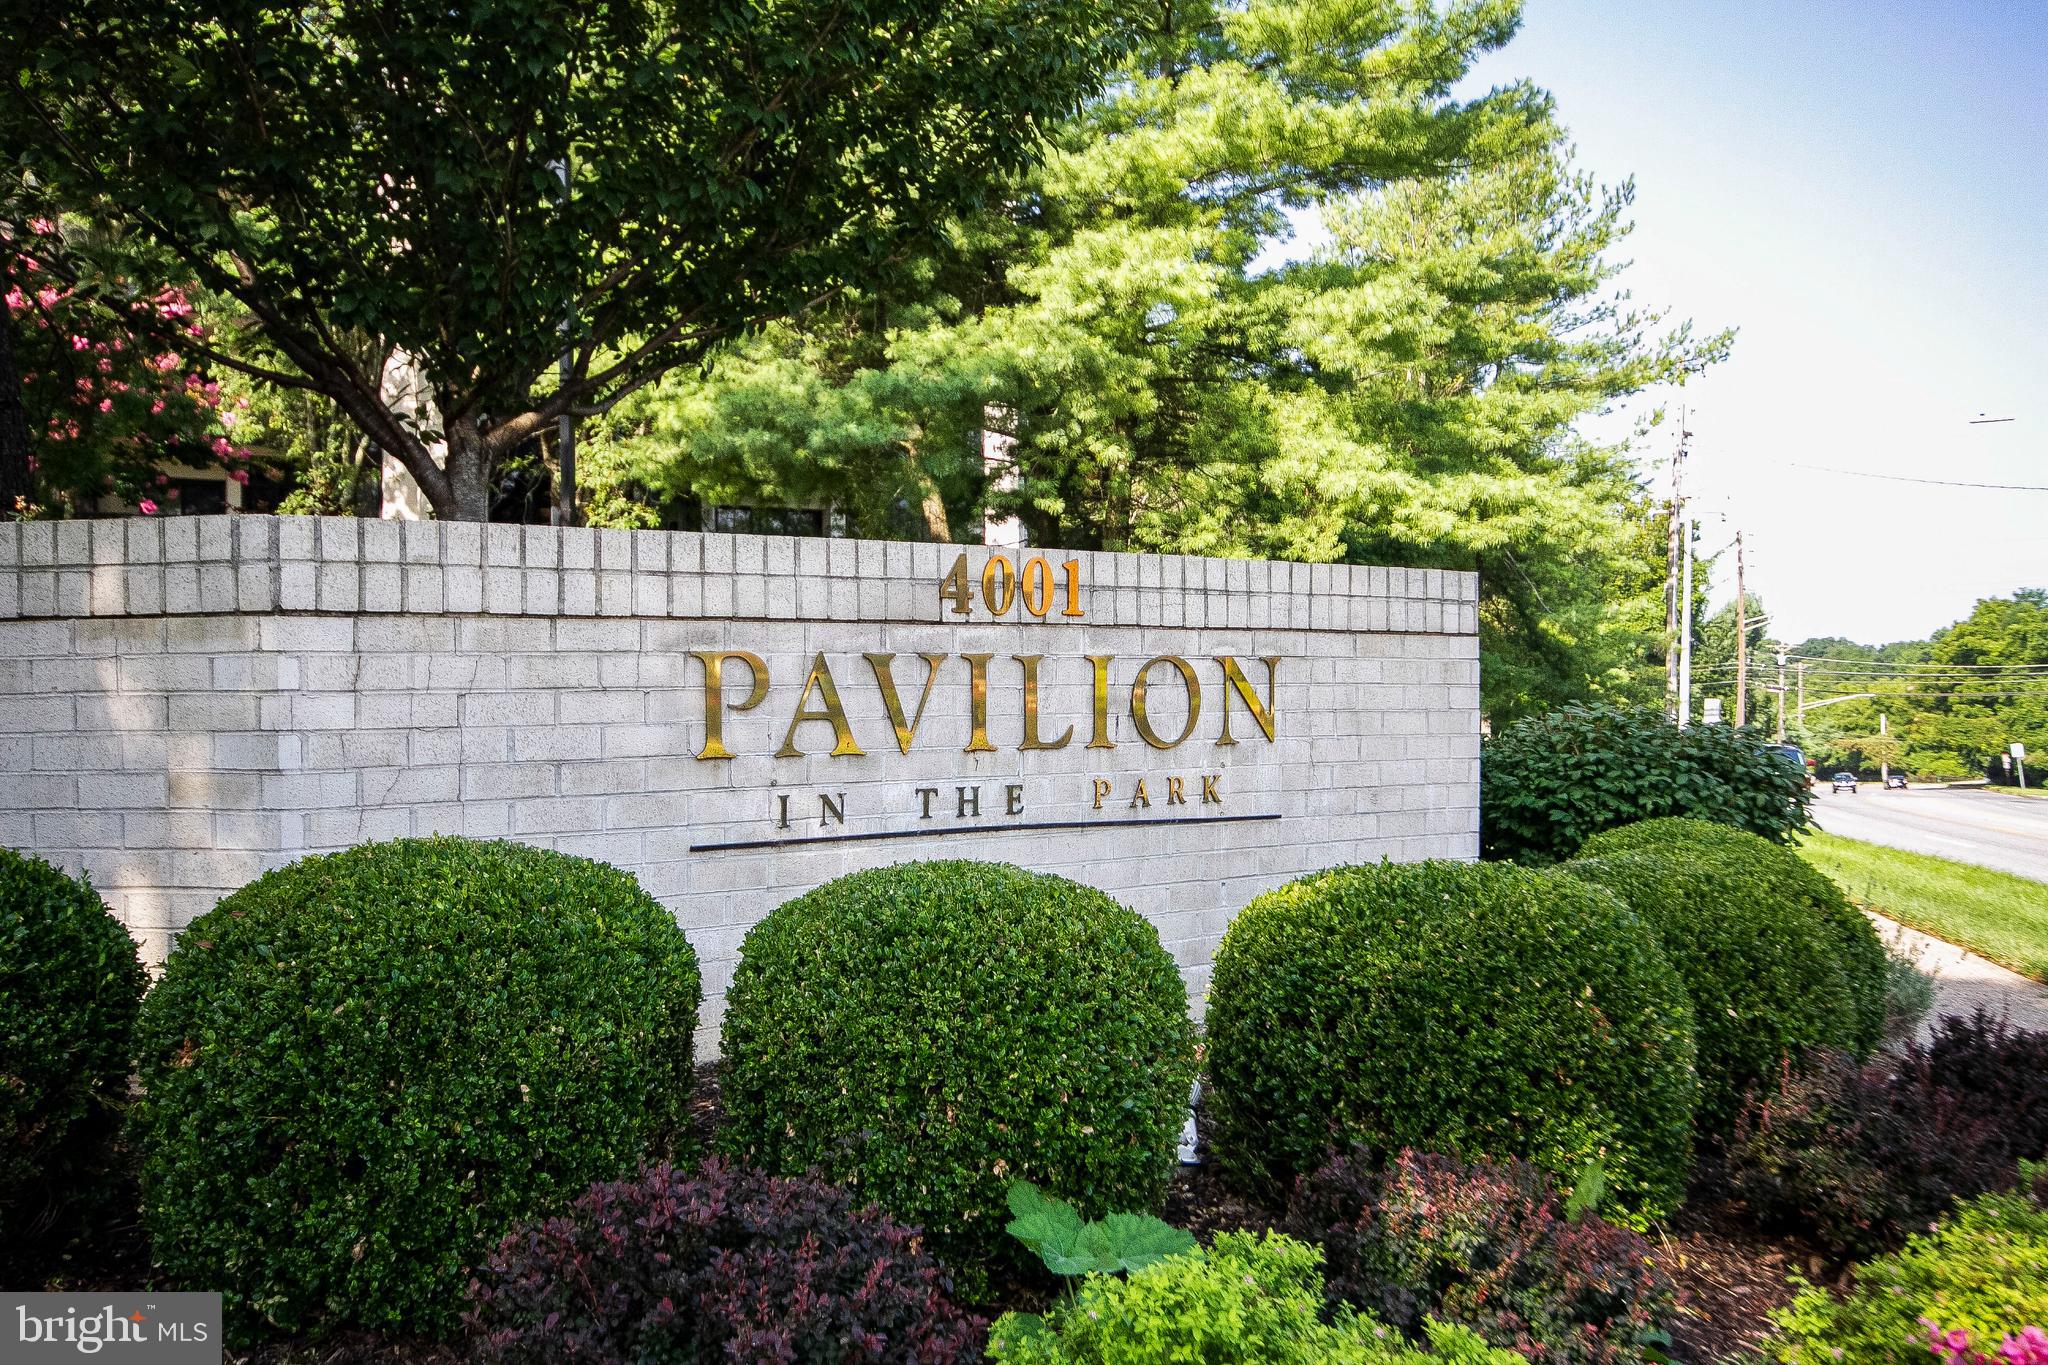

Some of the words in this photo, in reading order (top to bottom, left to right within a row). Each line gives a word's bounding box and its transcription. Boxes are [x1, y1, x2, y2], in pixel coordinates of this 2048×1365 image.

[939, 552, 1085, 618] 4001
[689, 650, 1281, 760] PAVILION
[777, 793, 846, 829] IN
[915, 784, 1024, 819] THE
[1093, 774, 1222, 810] PARK
